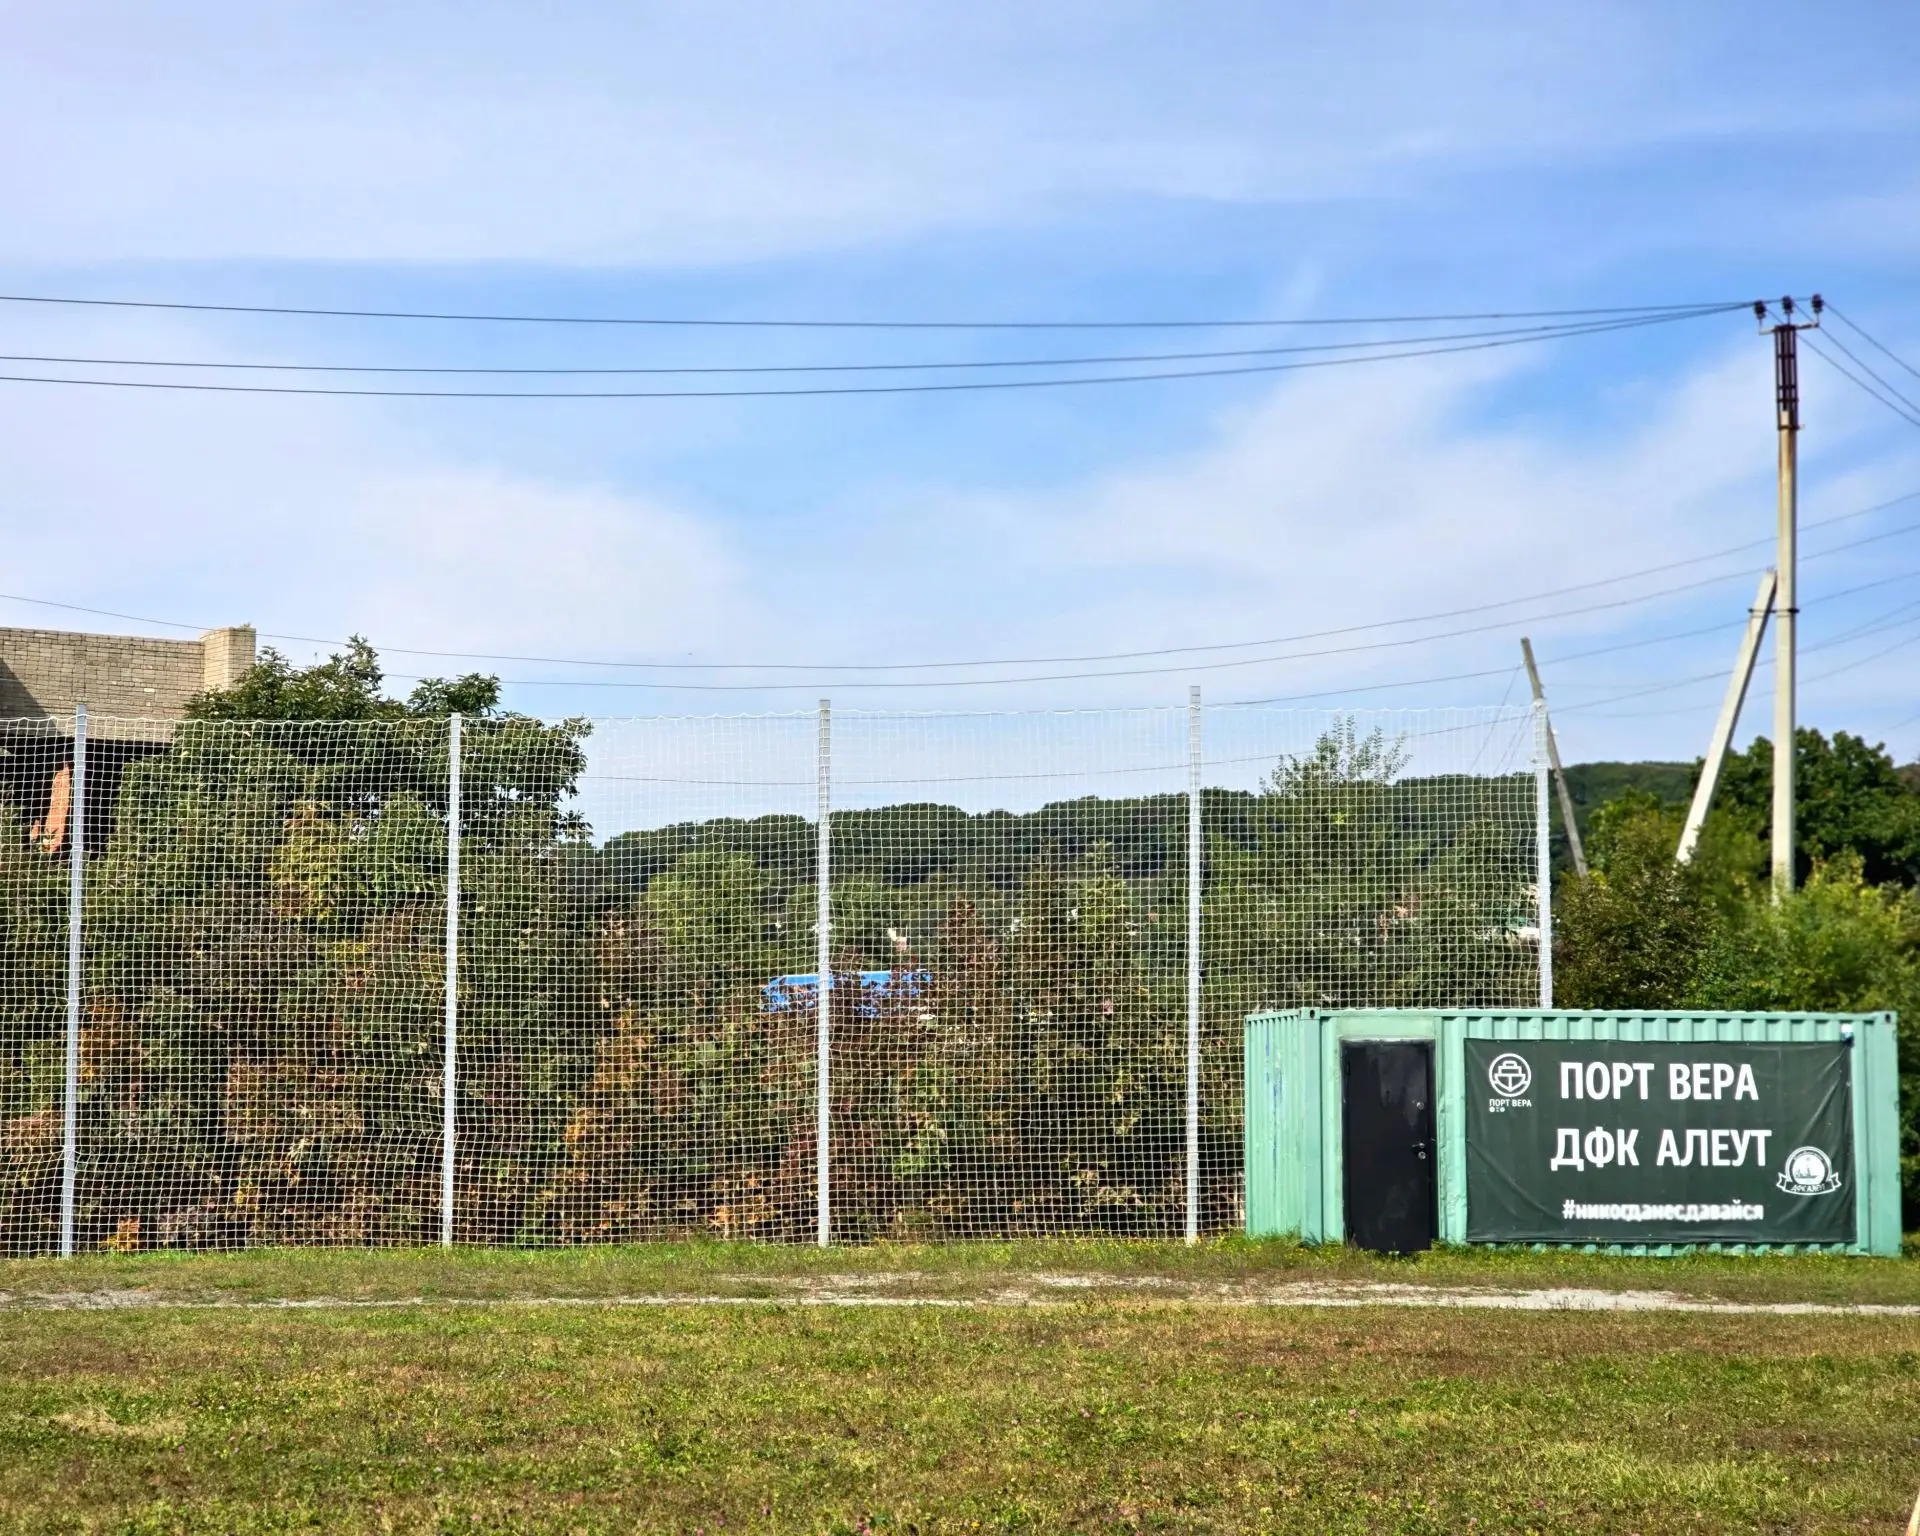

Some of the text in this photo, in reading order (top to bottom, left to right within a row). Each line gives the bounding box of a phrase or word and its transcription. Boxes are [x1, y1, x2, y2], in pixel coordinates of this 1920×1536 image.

[1560, 1062, 1760, 1101] ПОРТ ВЕРА
[1489, 1099, 1532, 1107] ПОРТ ВЕРА
[1550, 1126, 1773, 1172] ДФК АЛЕУТ
[1562, 1199, 1764, 1222] #никогданесдавайся
